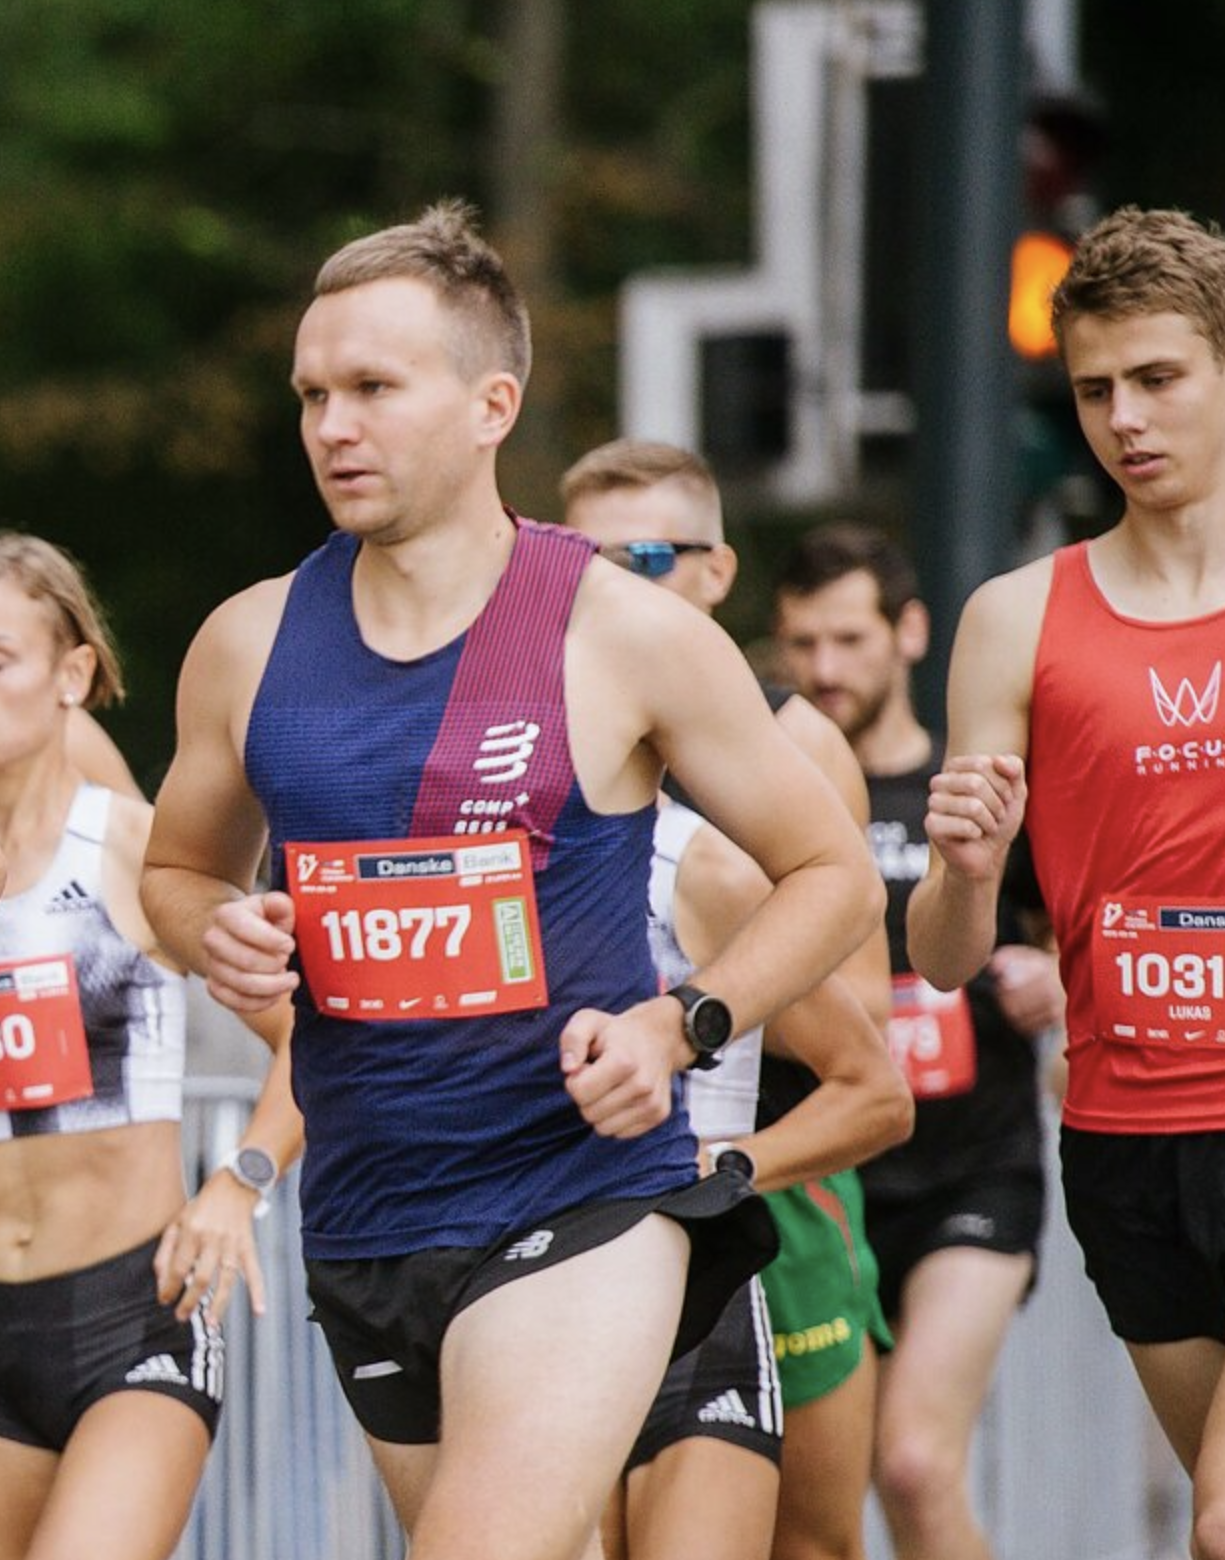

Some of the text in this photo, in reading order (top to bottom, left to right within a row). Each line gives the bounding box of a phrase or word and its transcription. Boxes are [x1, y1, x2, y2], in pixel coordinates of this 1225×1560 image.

[459, 799, 514, 817] COMP
[377, 856, 453, 876] Danske
[321, 904, 472, 961] 11877
[1115, 951, 1224, 999] 1031
[1168, 1005, 1212, 1021] LUKAS
